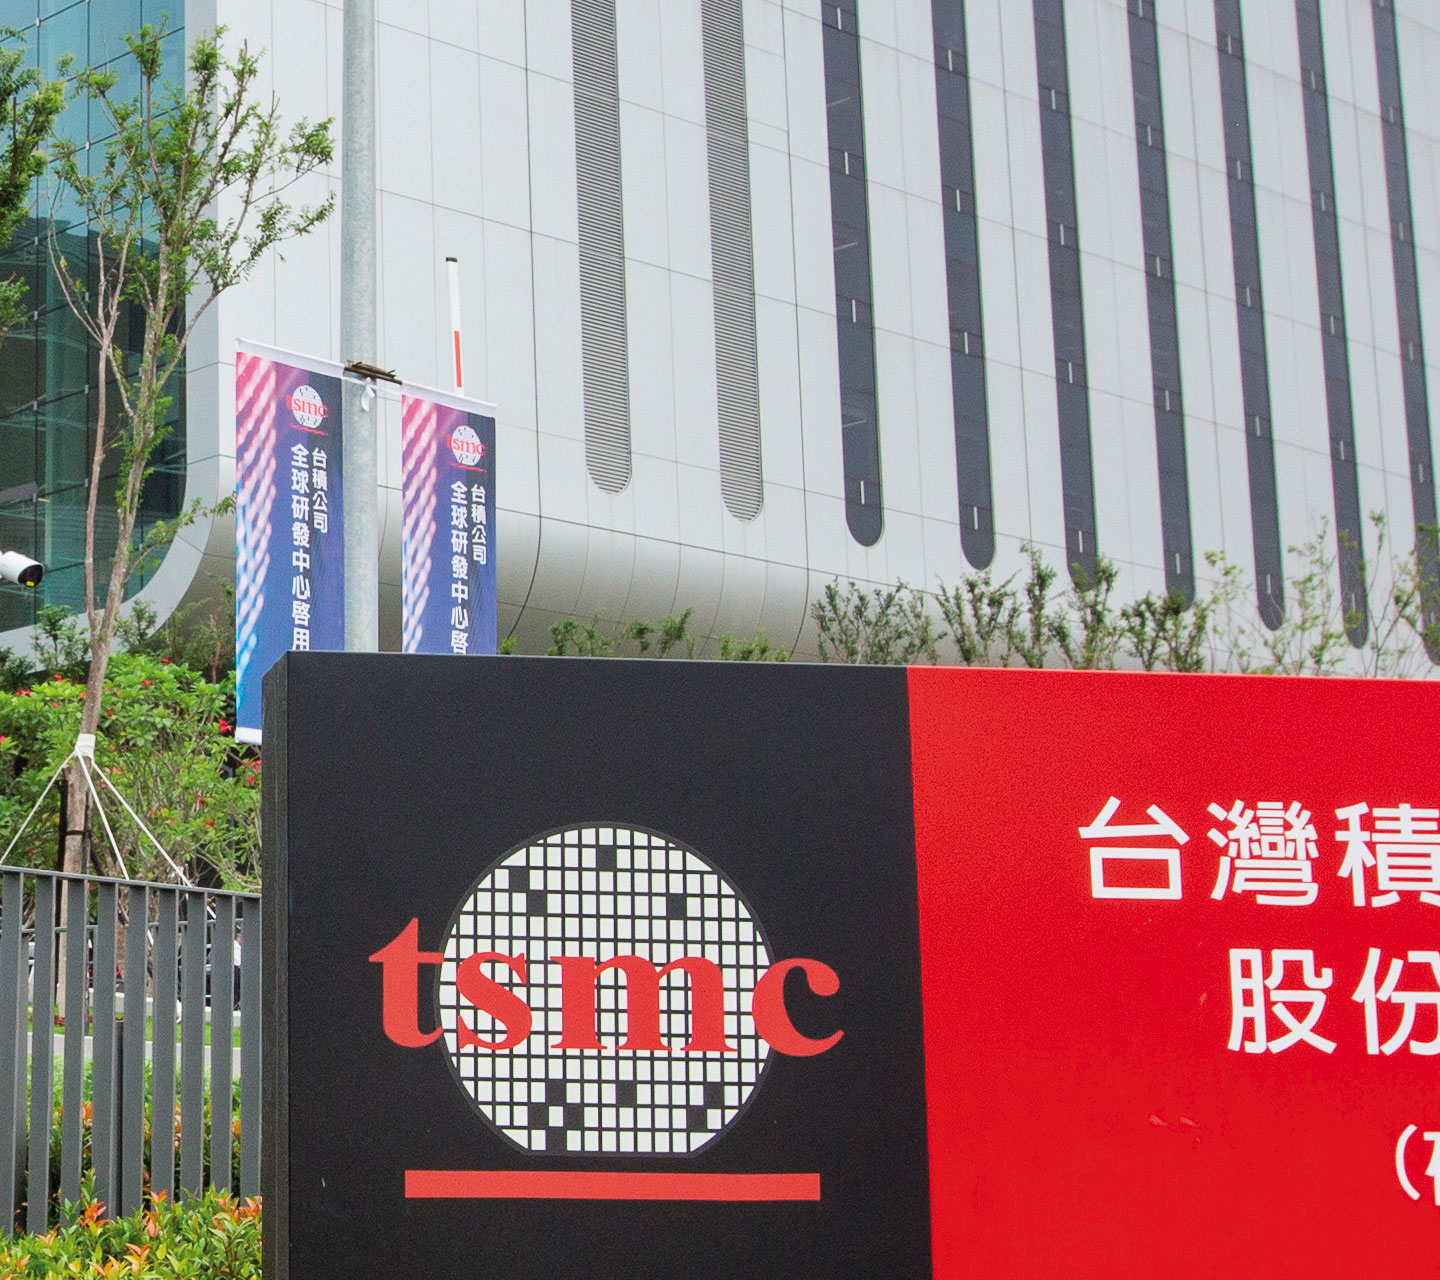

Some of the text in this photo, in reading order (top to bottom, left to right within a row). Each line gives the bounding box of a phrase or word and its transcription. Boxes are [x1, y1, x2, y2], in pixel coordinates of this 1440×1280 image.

[285, 393, 329, 419] tsmc
[446, 433, 487, 458] tsmc
[311, 447, 329, 534] 台積公司
[470, 483, 487, 565] 台積公司
[368, 917, 845, 1058] tsmc
